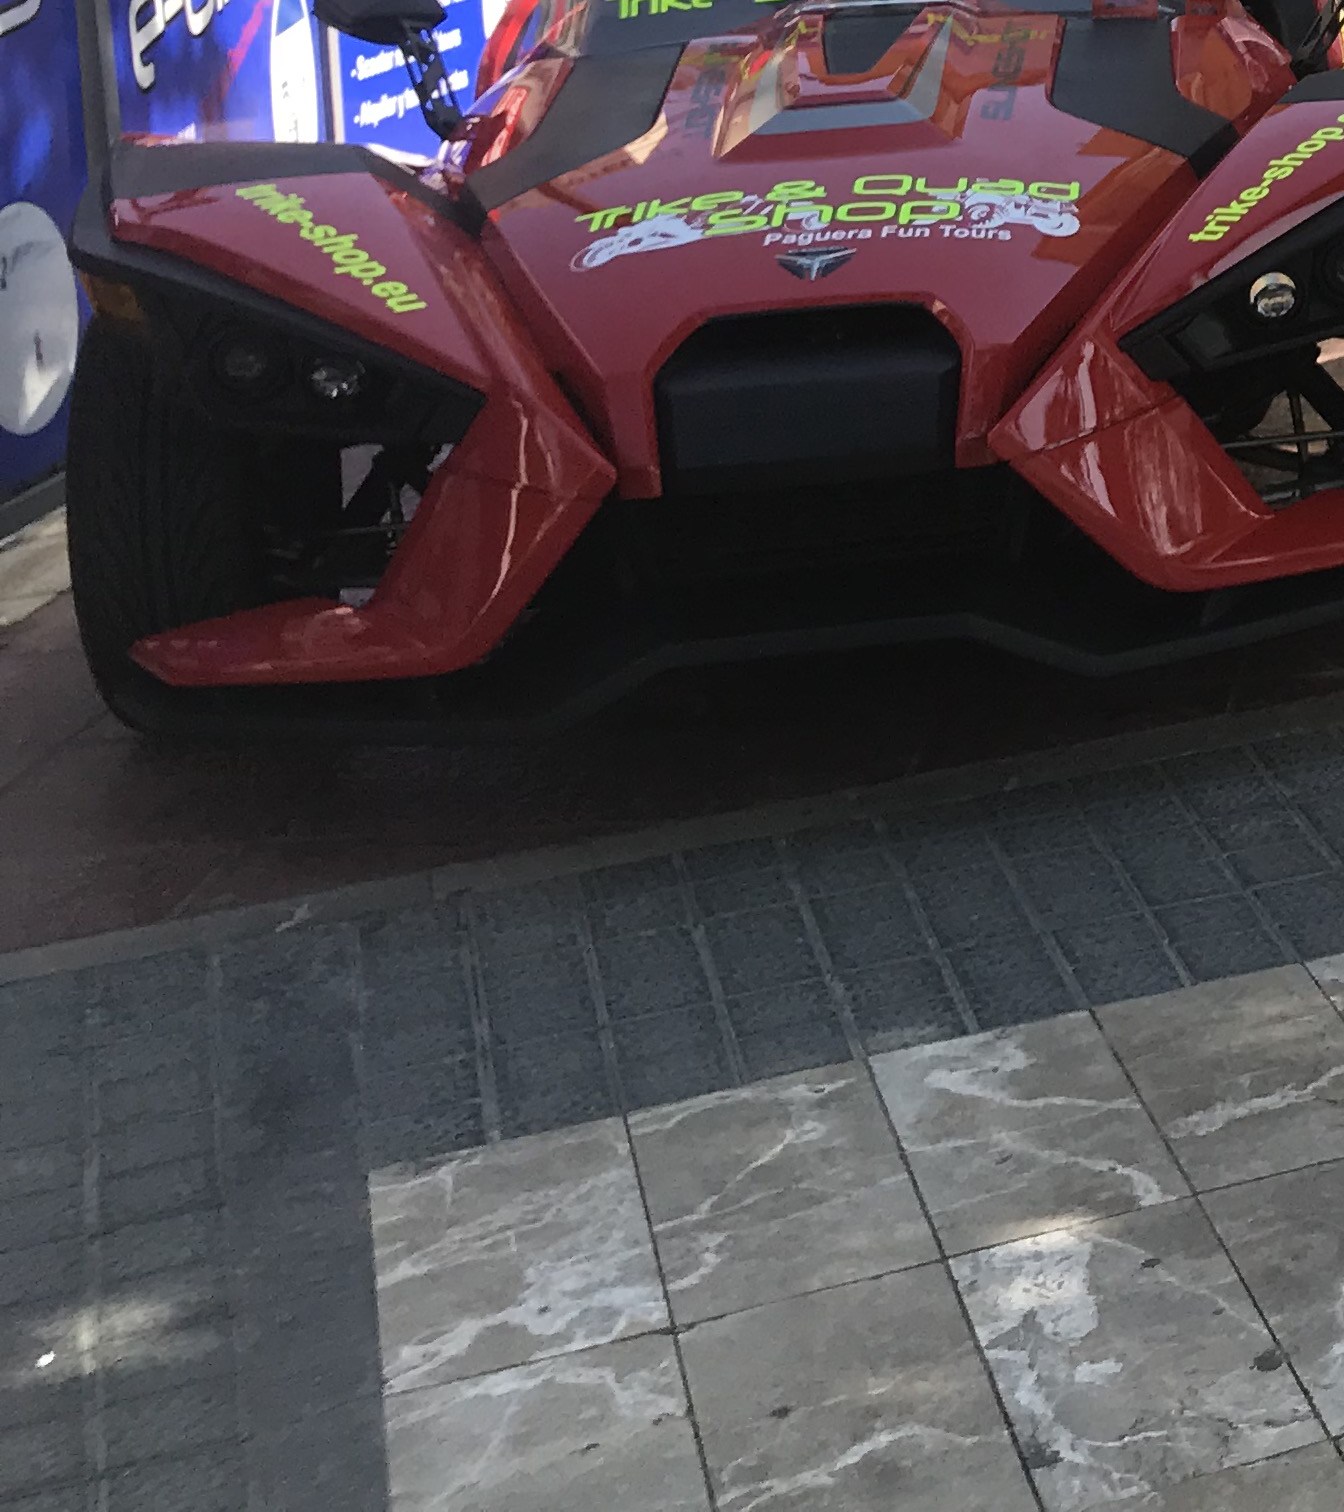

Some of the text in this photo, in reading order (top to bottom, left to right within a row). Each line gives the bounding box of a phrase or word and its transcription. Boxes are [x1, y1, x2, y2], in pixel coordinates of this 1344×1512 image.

[574, 173, 1081, 232] Trike & Quad
[700, 198, 962, 237] Shop
[762, 223, 1012, 248] Paguera Fun Tours
